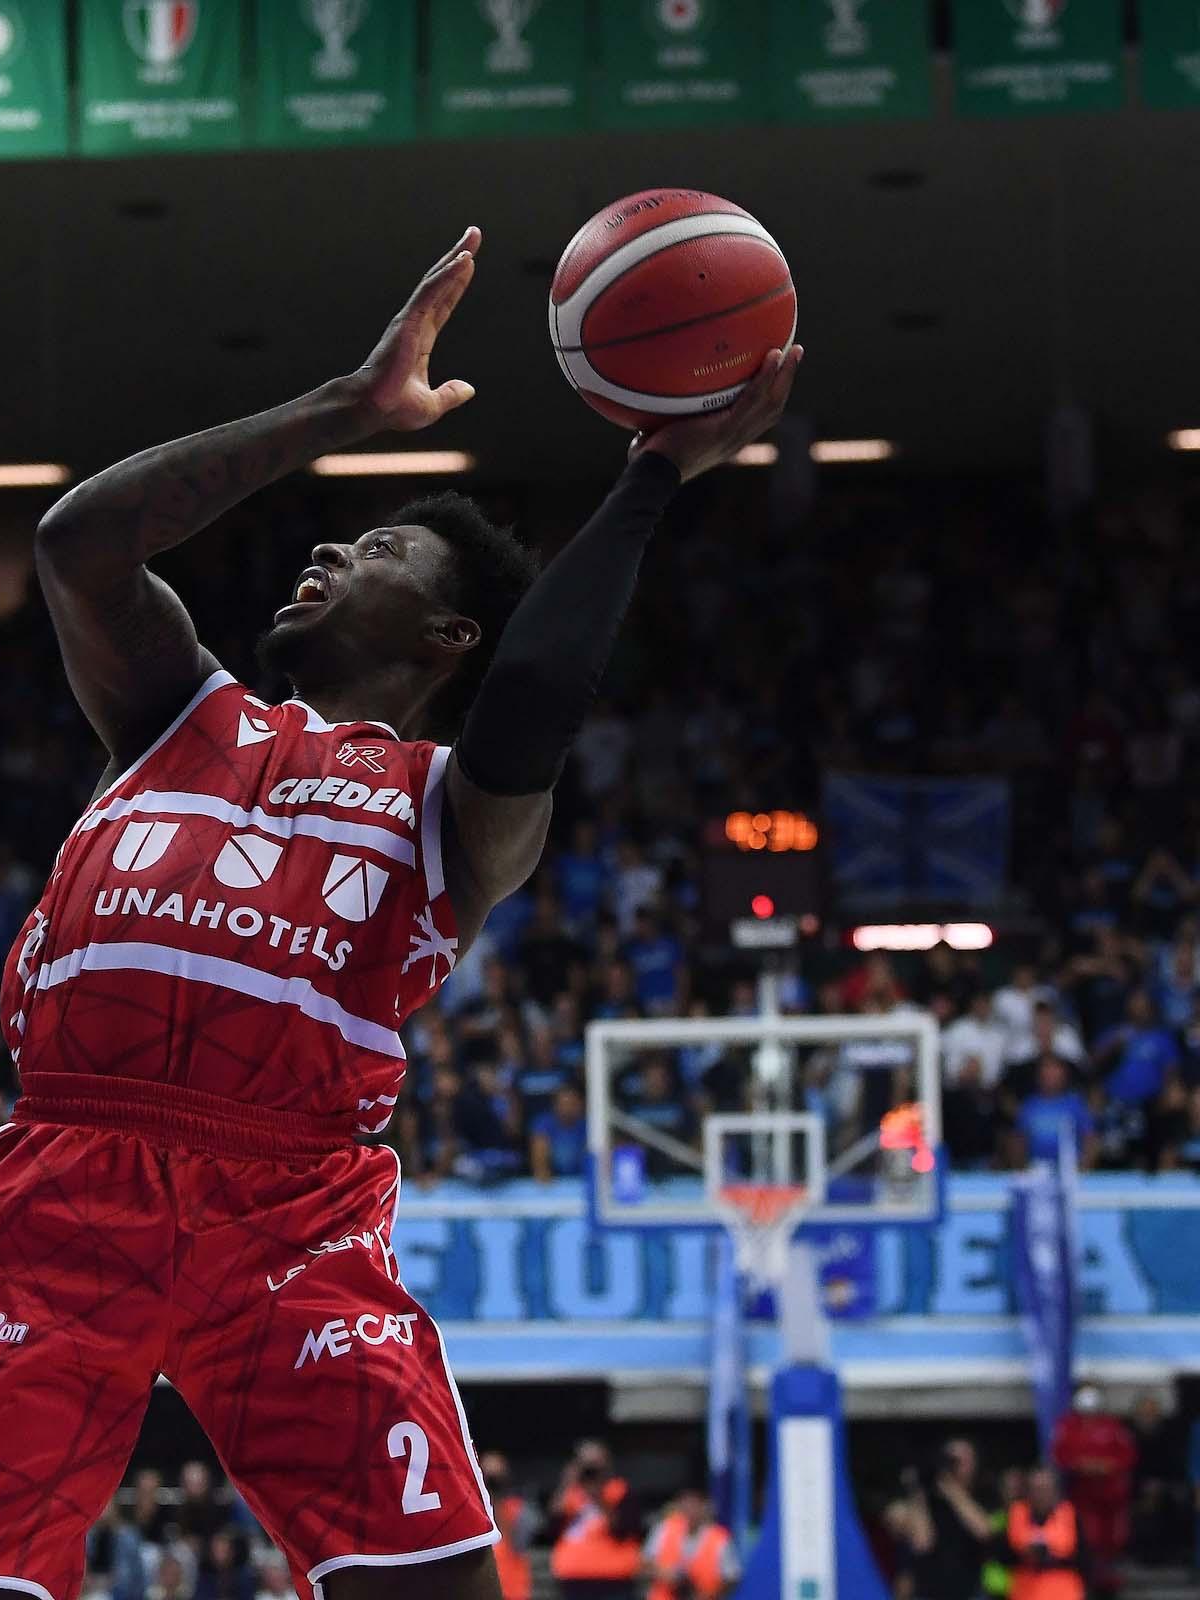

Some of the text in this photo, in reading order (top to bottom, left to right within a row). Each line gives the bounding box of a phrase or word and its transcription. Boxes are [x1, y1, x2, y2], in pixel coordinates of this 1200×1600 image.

[268, 776, 416, 831] CREDEM
[94, 887, 353, 971] UNAHOTELS
[388, 1421, 442, 1515] 2
